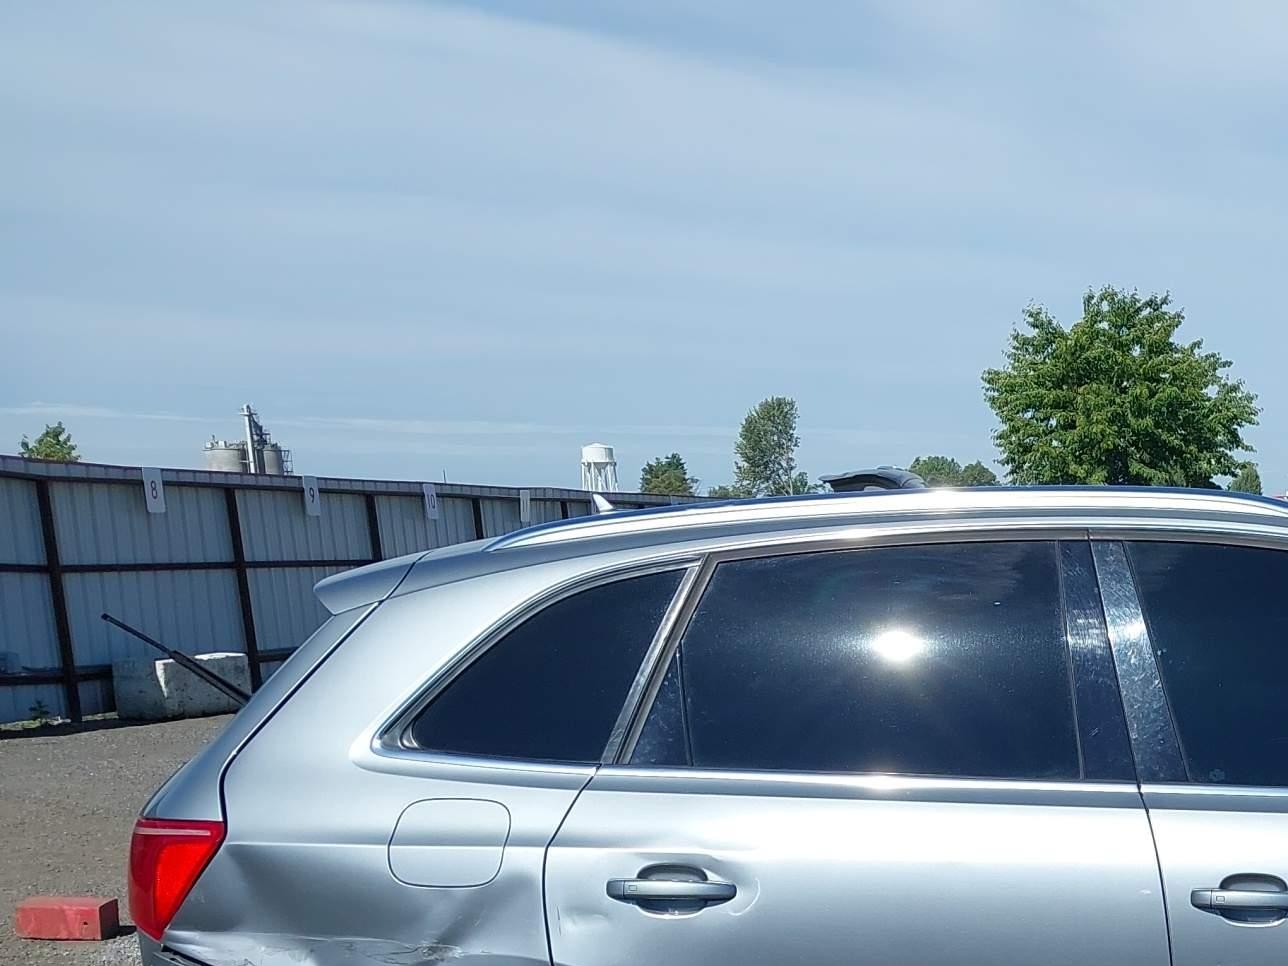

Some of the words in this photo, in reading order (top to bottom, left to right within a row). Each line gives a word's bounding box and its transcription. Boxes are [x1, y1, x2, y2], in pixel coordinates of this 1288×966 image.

[151, 480, 157, 499] 8
[309, 487, 314, 503] 9
[427, 494, 436, 509] 10
